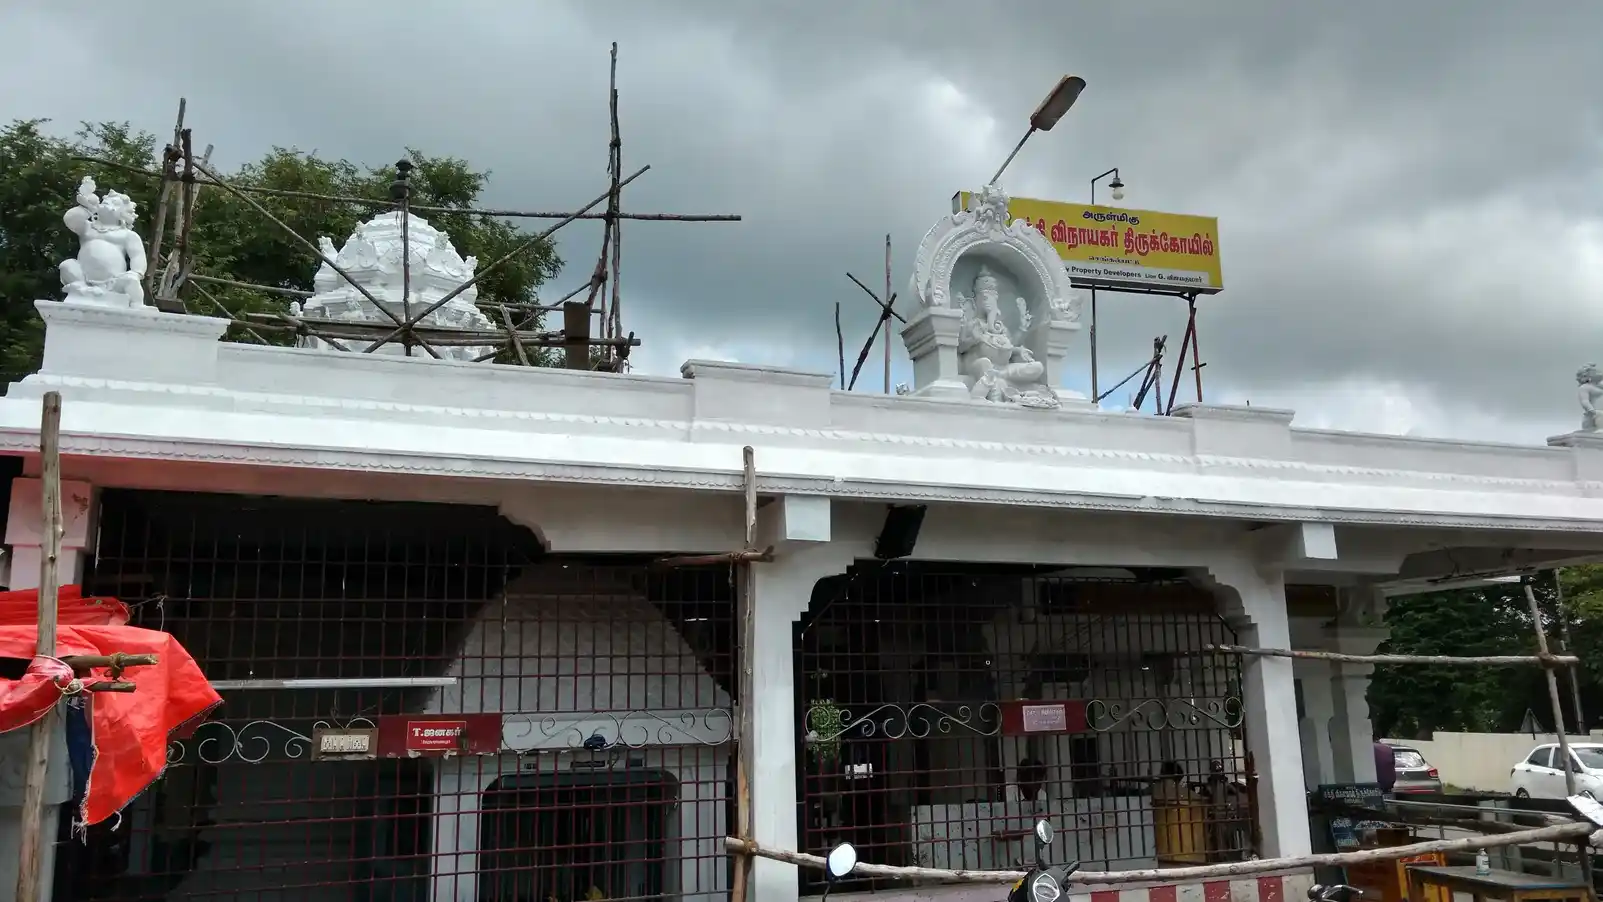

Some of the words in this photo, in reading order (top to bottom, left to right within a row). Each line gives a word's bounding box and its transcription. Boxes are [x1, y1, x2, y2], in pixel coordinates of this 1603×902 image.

[1082, 210, 1140, 225] அருள்மிகு
[1051, 219, 1119, 250] விநாயகர்
[1124, 227, 1214, 256] திருக்கோயில்
[1071, 266, 1102, 276] Property
[1103, 268, 1142, 279] Developers
